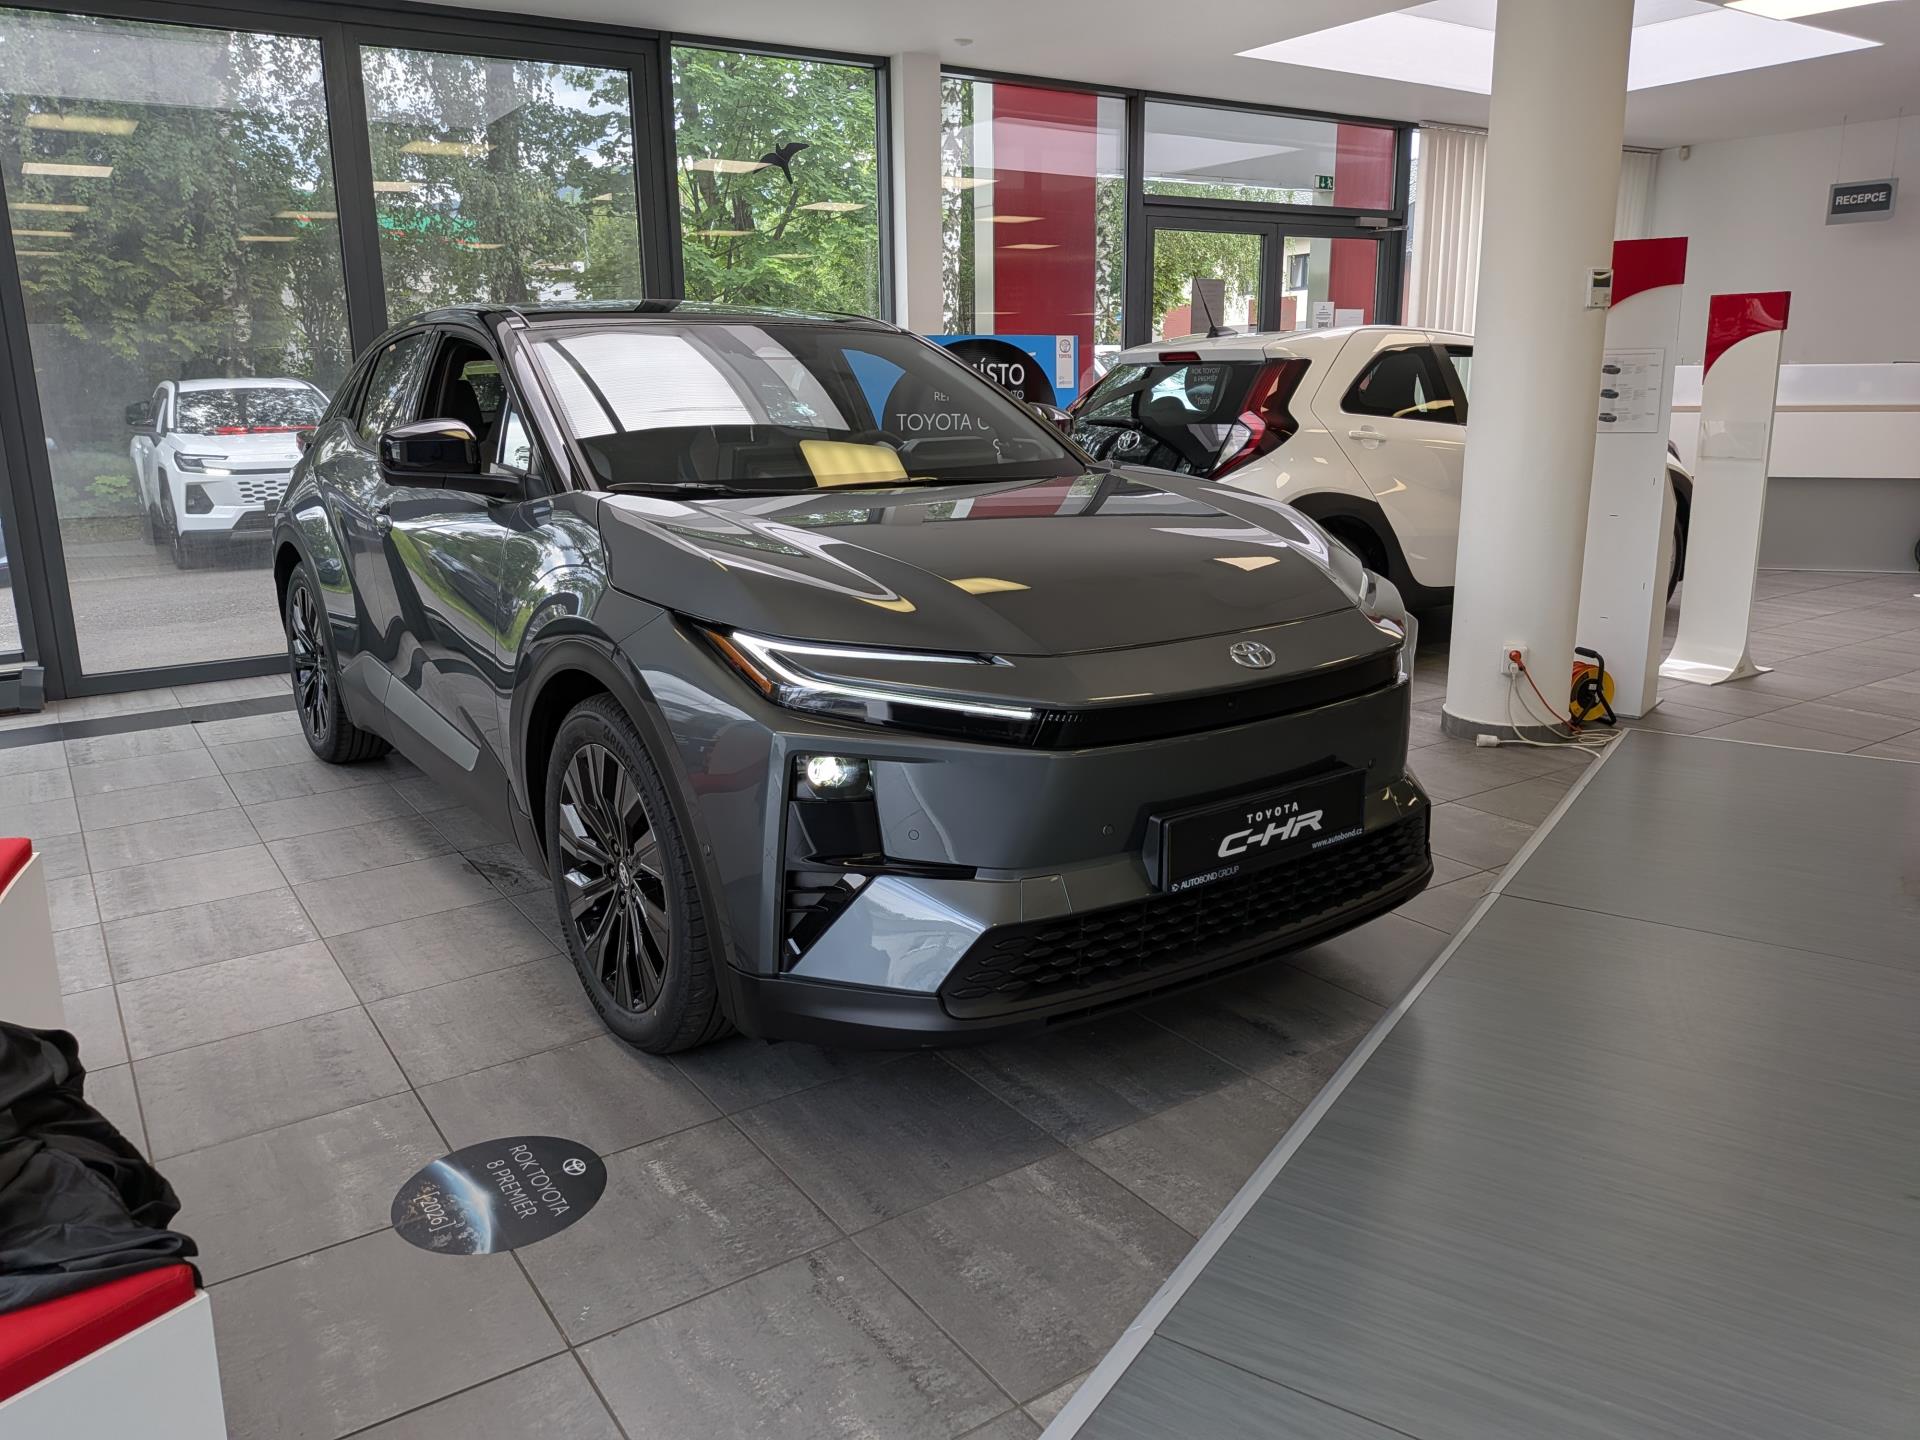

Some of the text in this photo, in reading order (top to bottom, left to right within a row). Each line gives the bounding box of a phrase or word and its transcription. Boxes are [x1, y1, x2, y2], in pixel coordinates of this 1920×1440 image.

[1835, 191, 1887, 206] RECEPCE
[896, 413, 972, 431] TOYOTA
[1246, 801, 1300, 824] TOYOTA
[1217, 809, 1323, 858] C-HR
[1311, 828, 1363, 849] www.autobond.cz
[1180, 865, 1240, 890] AUTOBOND GROUP
[486, 1159, 537, 1219] 8 PREMIÉR
[509, 1144, 571, 1217] ROK TOYOTA
